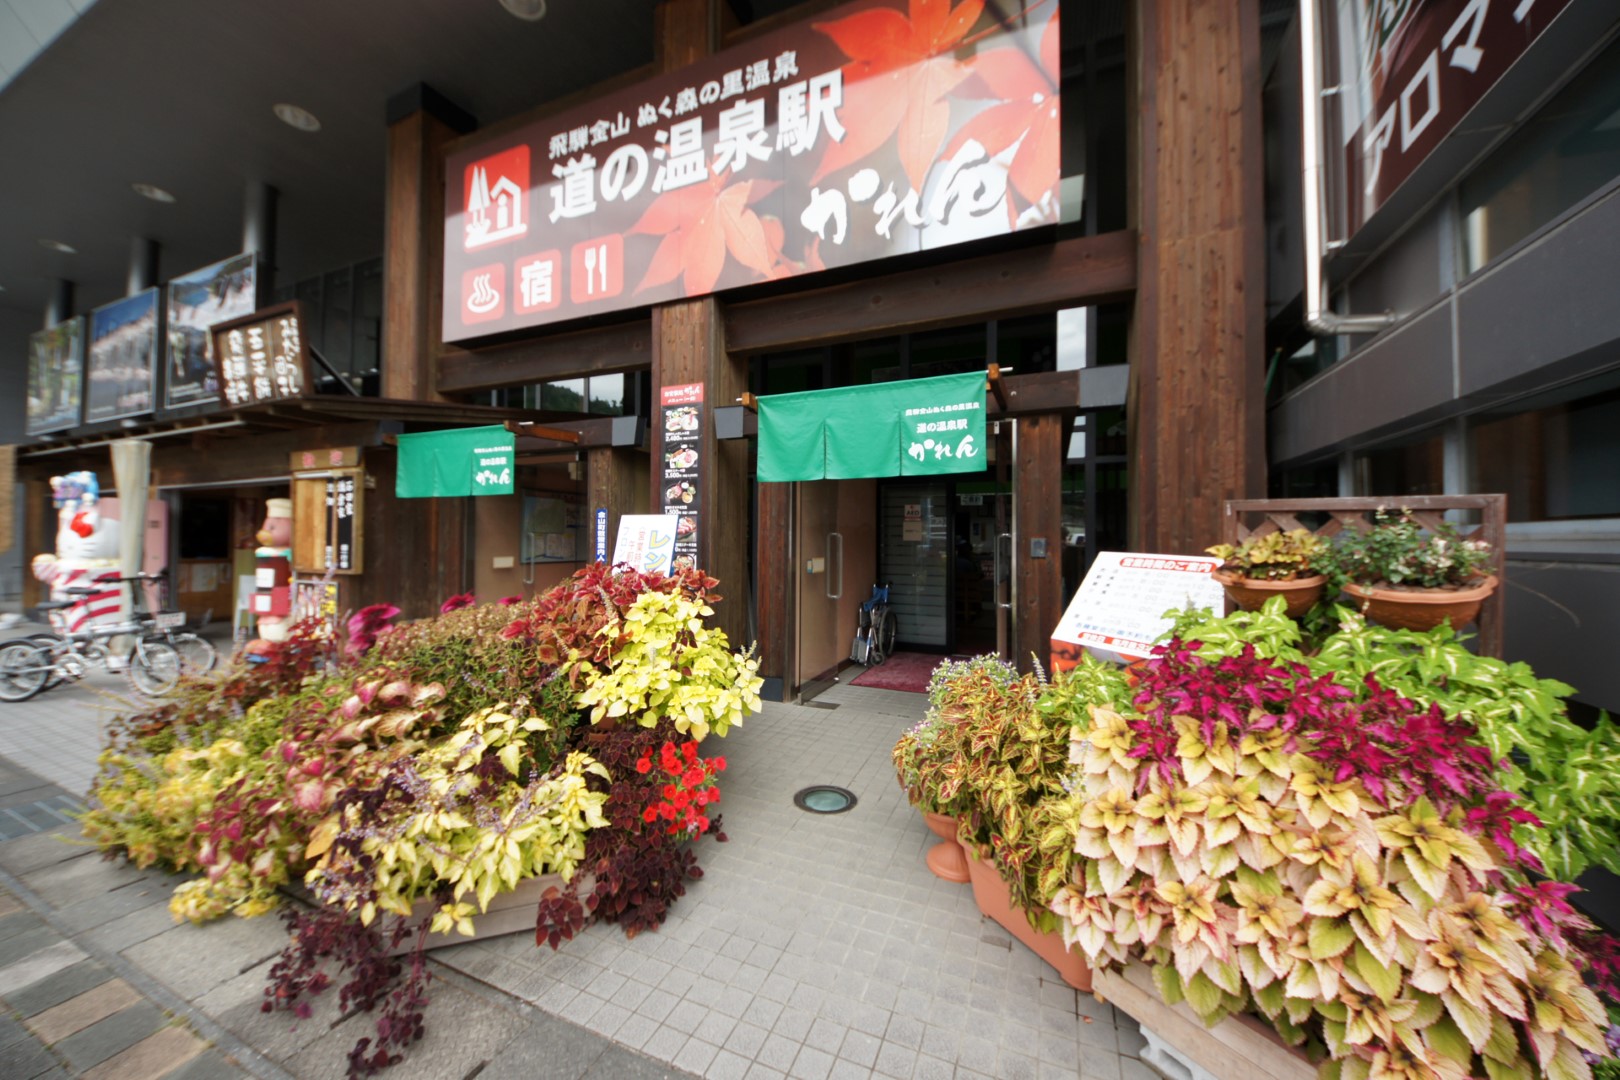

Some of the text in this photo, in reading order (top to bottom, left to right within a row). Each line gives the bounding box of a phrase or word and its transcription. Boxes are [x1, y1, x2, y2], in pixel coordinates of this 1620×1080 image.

[548, 49, 800, 161] 飛騨金山 ぬく森の里温泉
[548, 68, 847, 225] 道の温泉駅
[1362, 0, 1537, 197] アロマ
[519, 259, 554, 309] 宿
[916, 418, 968, 434] 道の温泉駅
